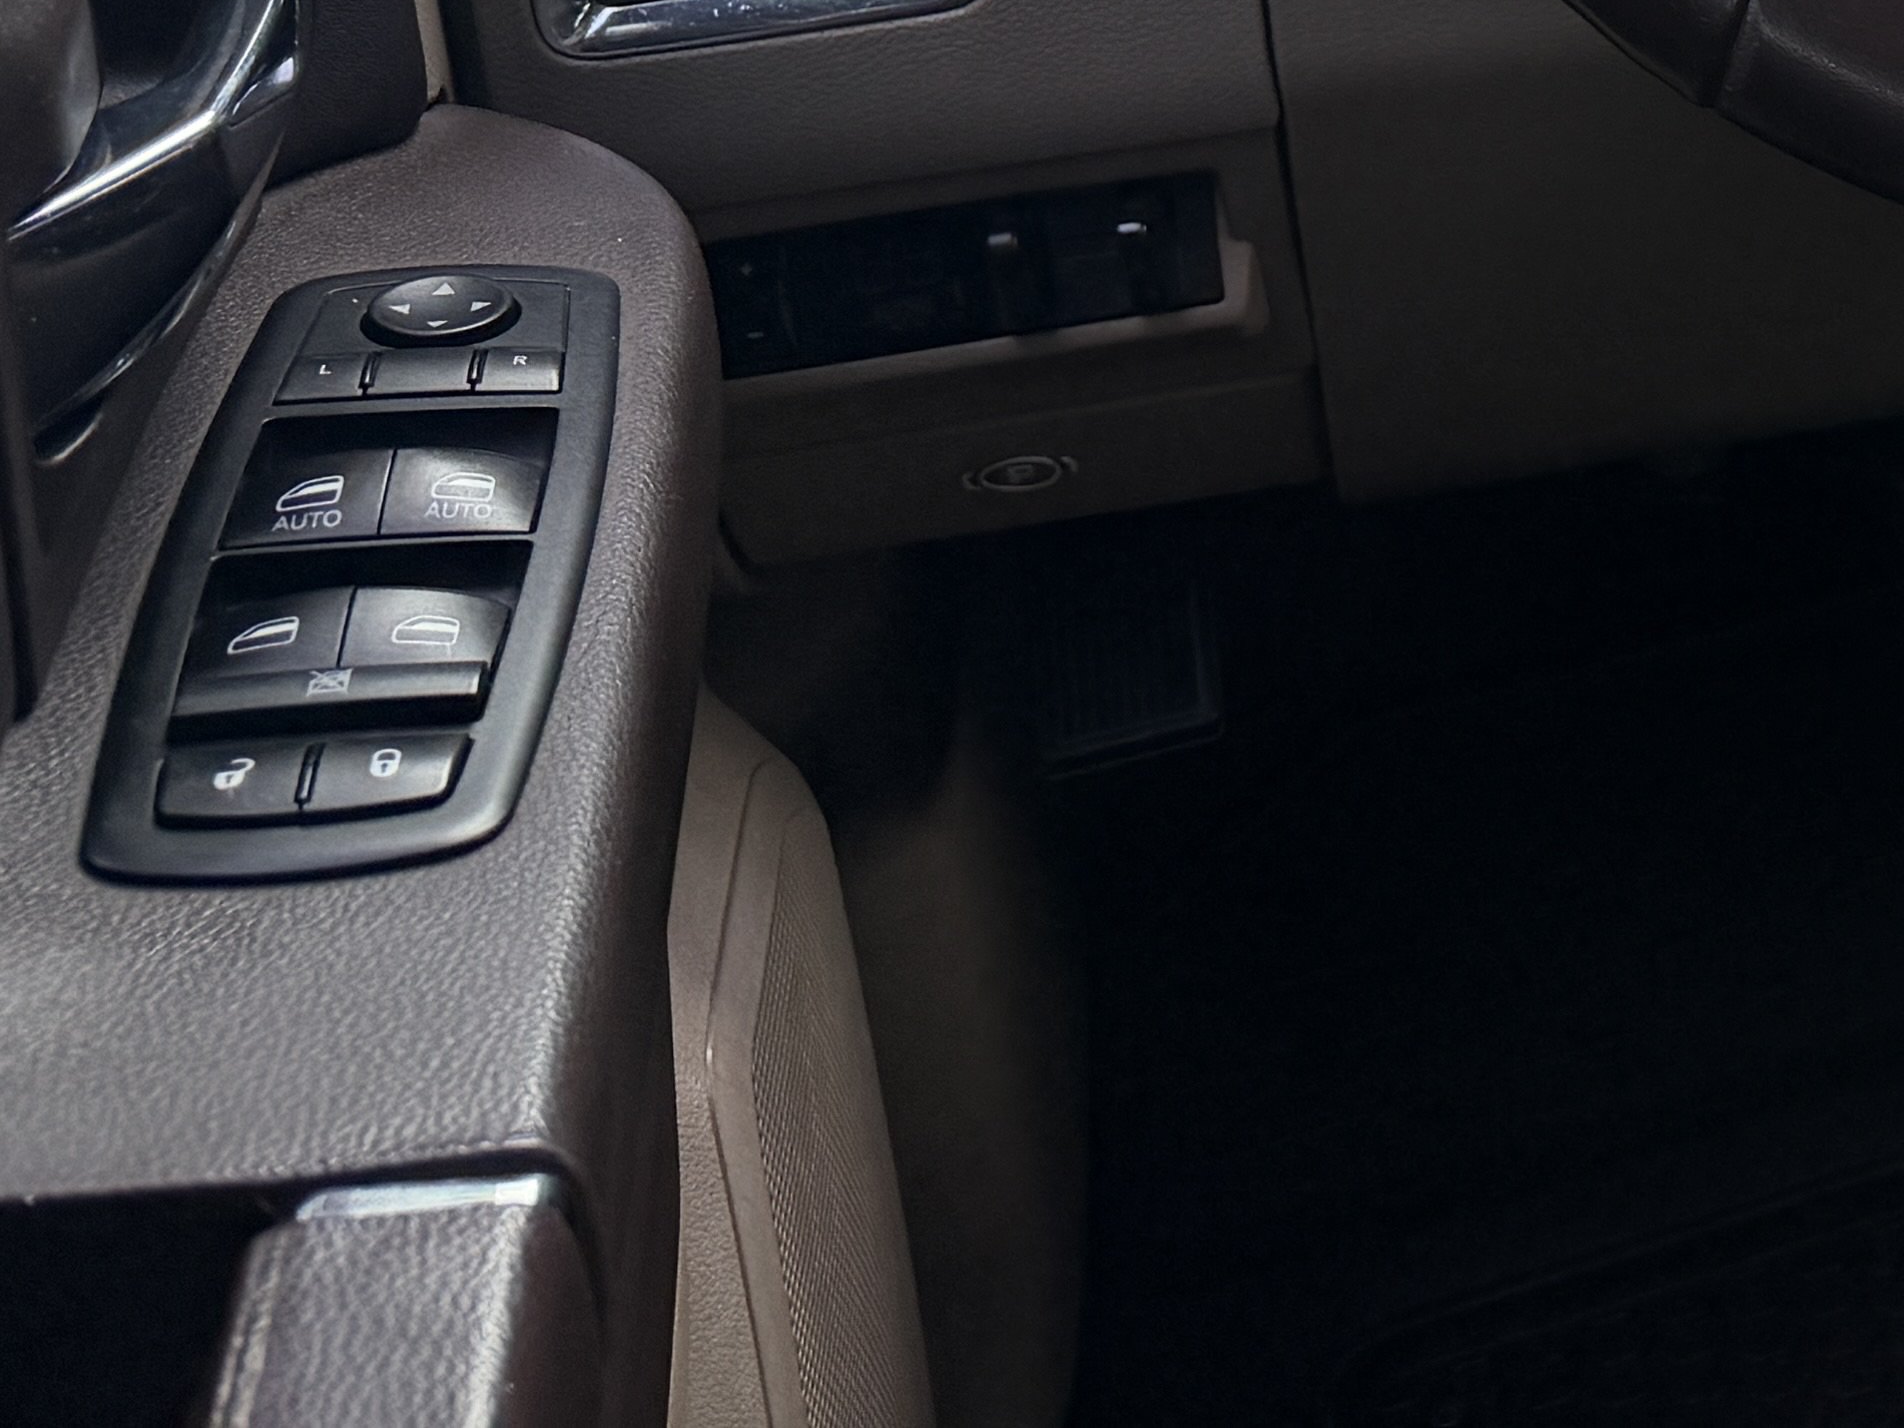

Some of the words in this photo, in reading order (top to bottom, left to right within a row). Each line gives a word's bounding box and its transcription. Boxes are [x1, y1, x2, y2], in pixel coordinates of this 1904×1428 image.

[512, 354, 528, 366] R
[319, 363, 332, 375] L
[424, 499, 493, 521] AUTO
[271, 507, 343, 533] AUTO
